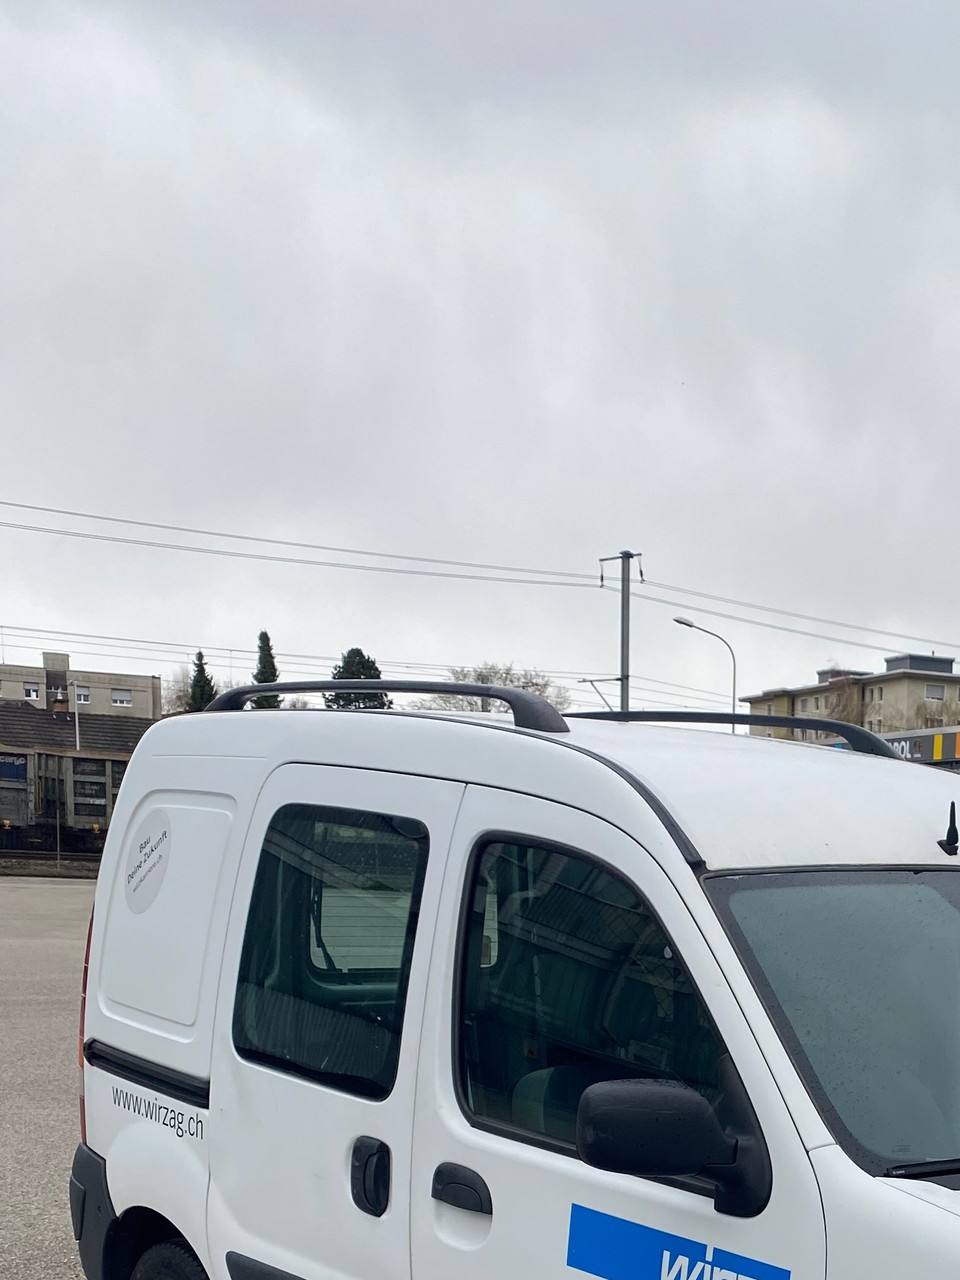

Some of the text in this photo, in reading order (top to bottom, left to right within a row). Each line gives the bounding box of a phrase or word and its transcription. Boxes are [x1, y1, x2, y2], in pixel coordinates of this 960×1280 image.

[127, 830, 168, 885] Deine Zukunft
[139, 835, 151, 854] Bau
[112, 1086, 204, 1140] www.wirzag.ch
